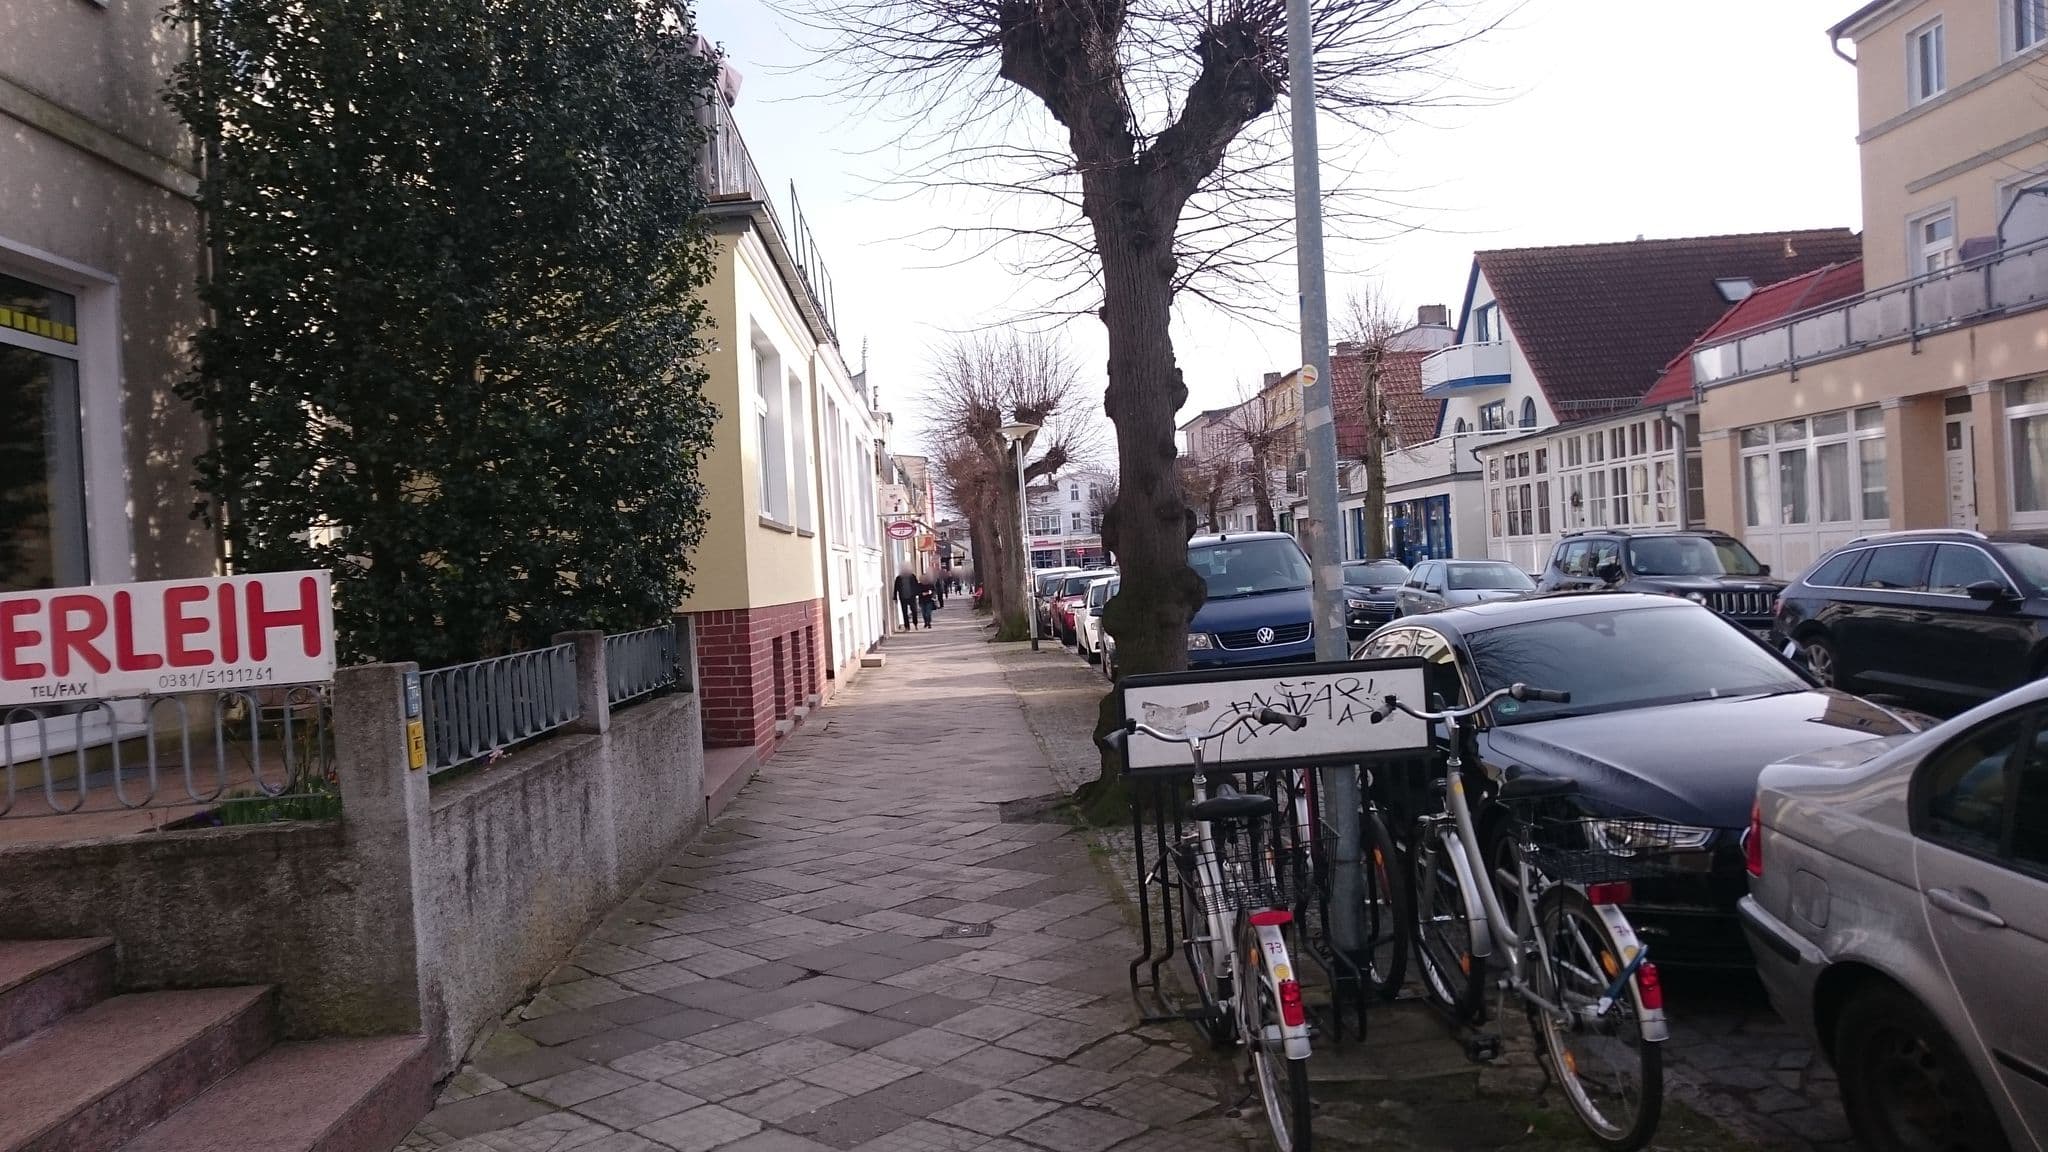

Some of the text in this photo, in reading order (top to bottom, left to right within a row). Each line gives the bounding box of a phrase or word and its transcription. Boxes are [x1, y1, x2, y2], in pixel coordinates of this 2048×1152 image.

[0, 576, 322, 681] ERLEIH
[31, 667, 272, 698] TEL/FAX 0381/5191261
[1264, 942, 1284, 955] 73
